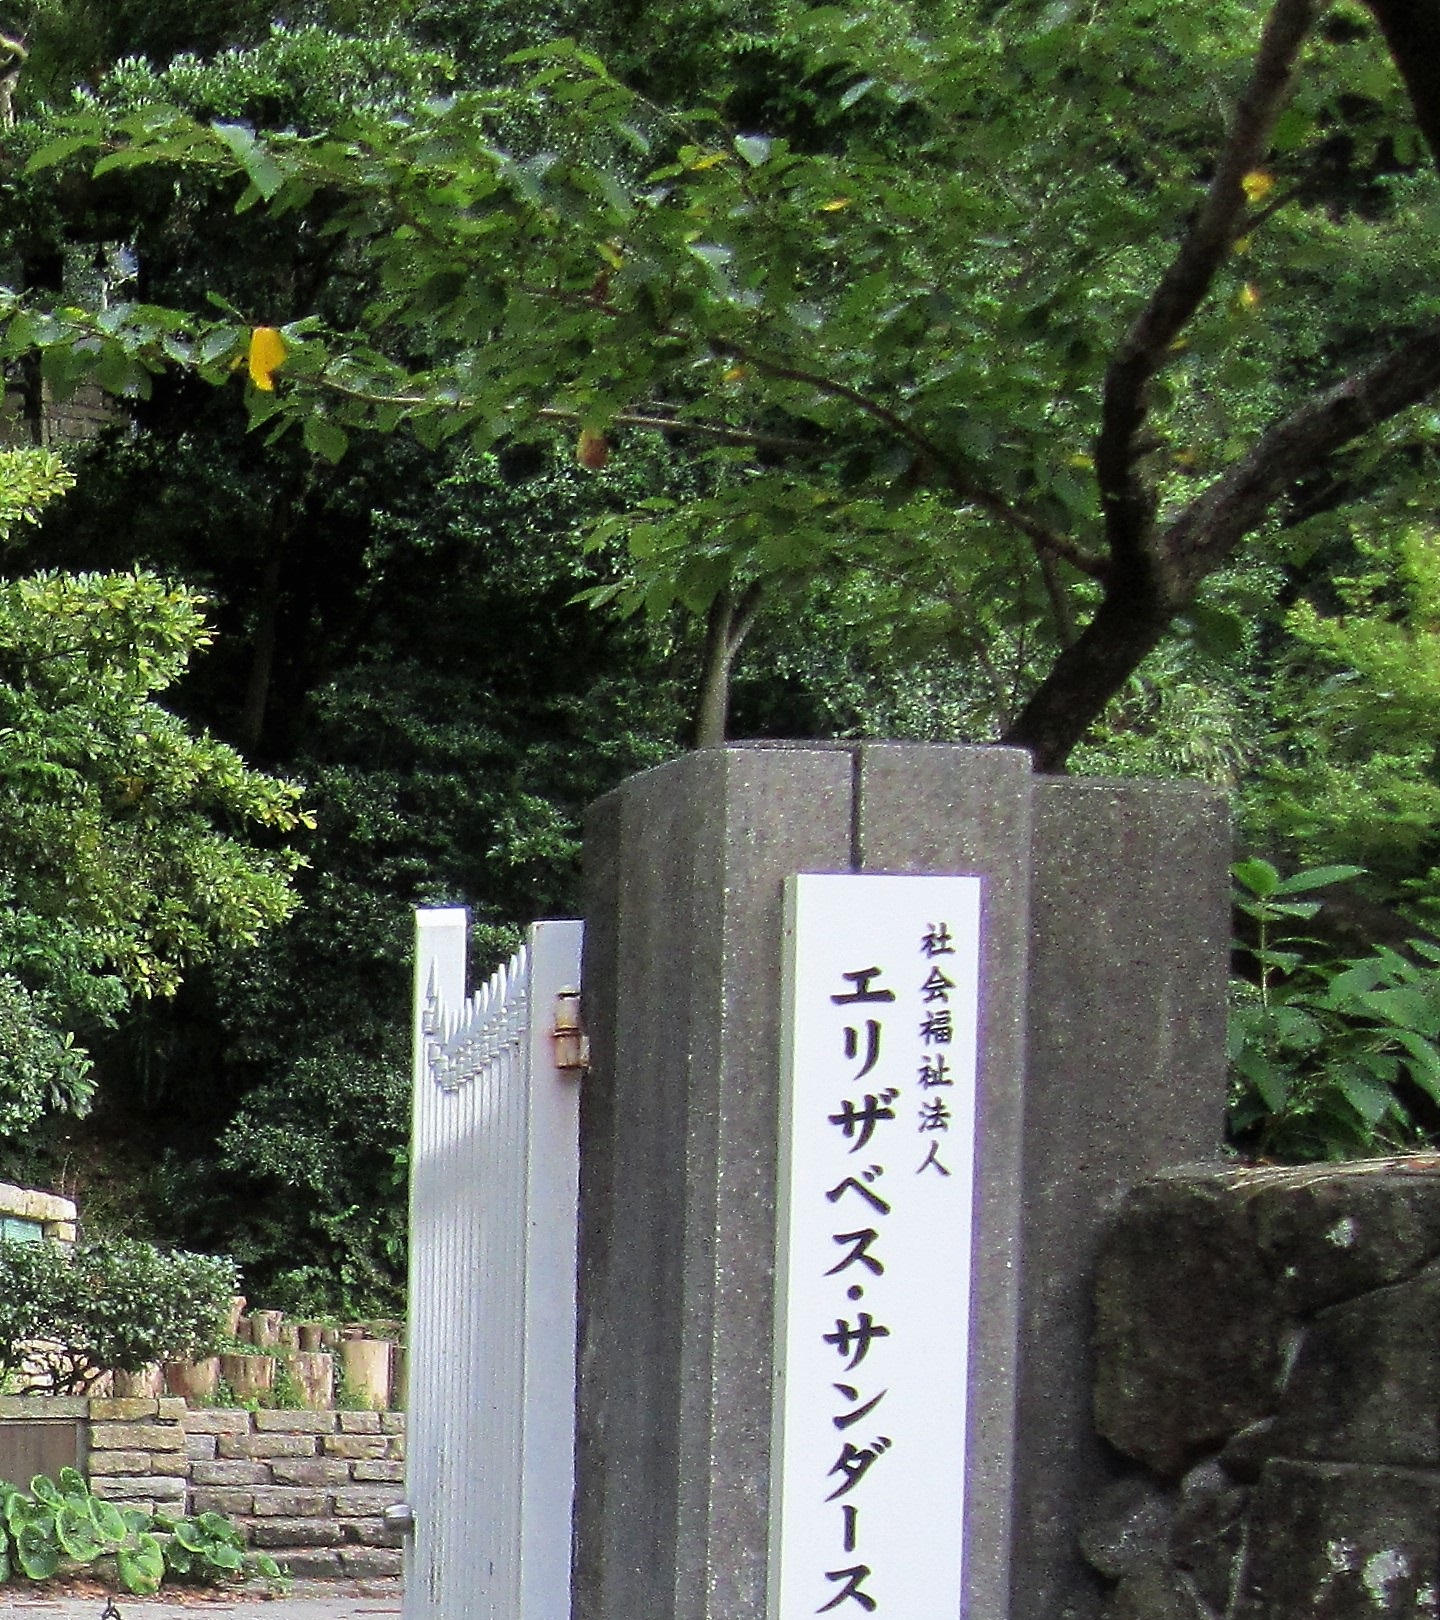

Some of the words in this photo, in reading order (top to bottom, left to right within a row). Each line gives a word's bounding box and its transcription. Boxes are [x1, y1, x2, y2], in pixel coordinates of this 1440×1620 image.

[915, 921, 957, 1179] 社会福祉法人
